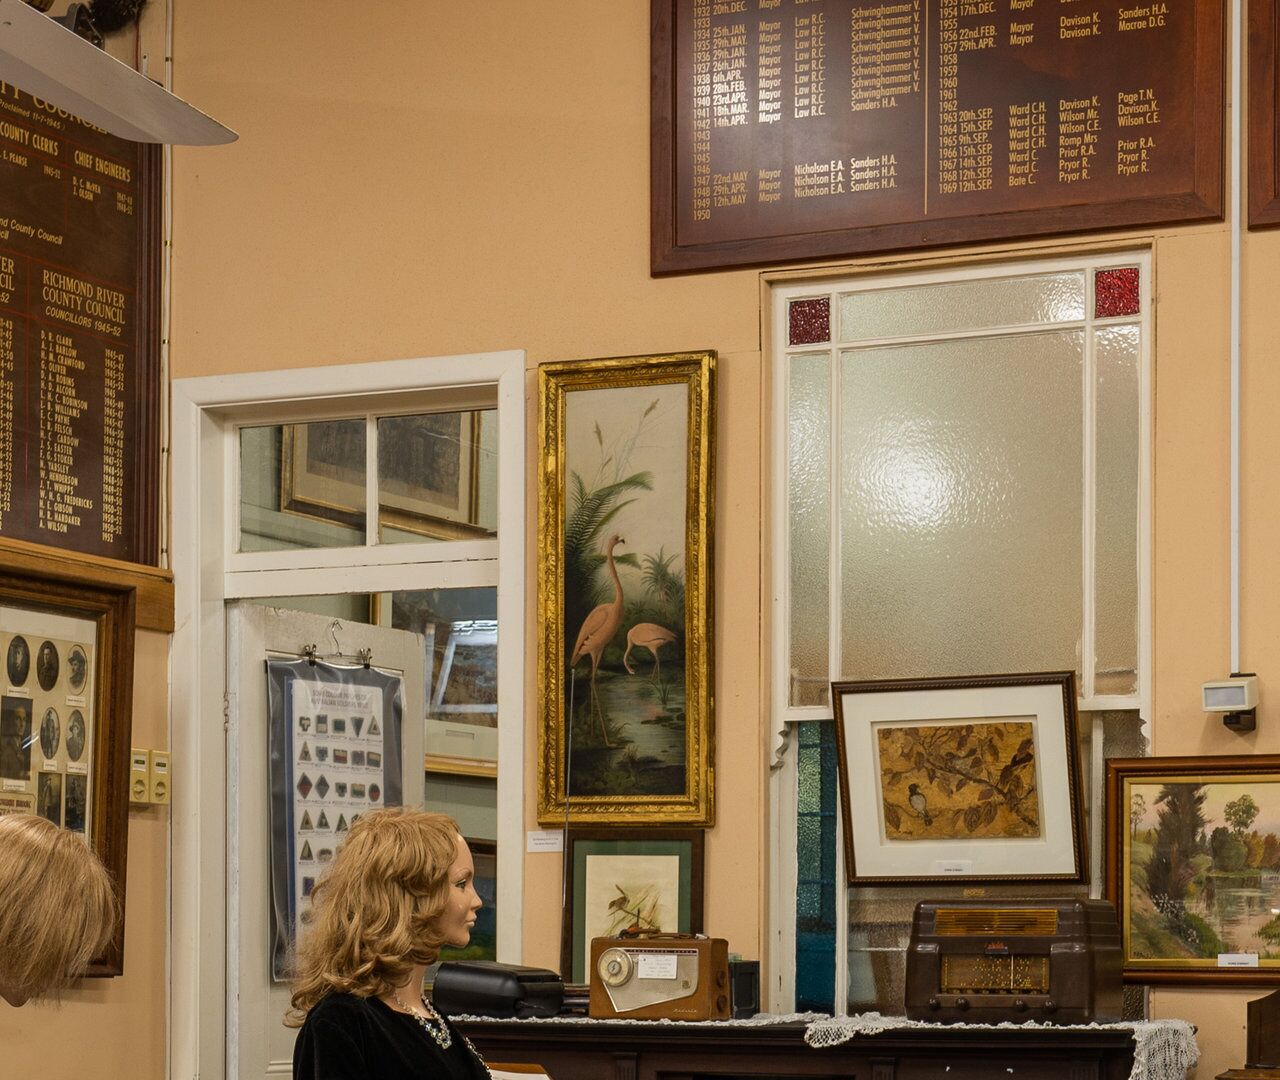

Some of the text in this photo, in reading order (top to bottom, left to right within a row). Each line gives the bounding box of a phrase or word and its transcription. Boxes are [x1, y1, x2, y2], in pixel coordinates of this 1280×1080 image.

[0, 121, 58, 156] COUNTY CLERKS
[75, 150, 130, 183] CHIEF ENGINEERS
[694, 176, 710, 187] 1947
[759, 169, 781, 180] Mayor
[794, 164, 829, 175] Nicholson
[851, 157, 880, 169] Sanders
[940, 182, 957, 194] 1969
[1009, 176, 1026, 187] Bate
[1059, 172, 1080, 183] Pryor
[1118, 164, 1139, 176] Pryor
[11, 219, 35, 238] County
[38, 229, 63, 245] Council
[43, 270, 125, 308] RICHMOND RIVER
[43, 287, 125, 324] COUNTY COUNCIL
[46, 306, 121, 336] COUNCILLORS 1945-52
